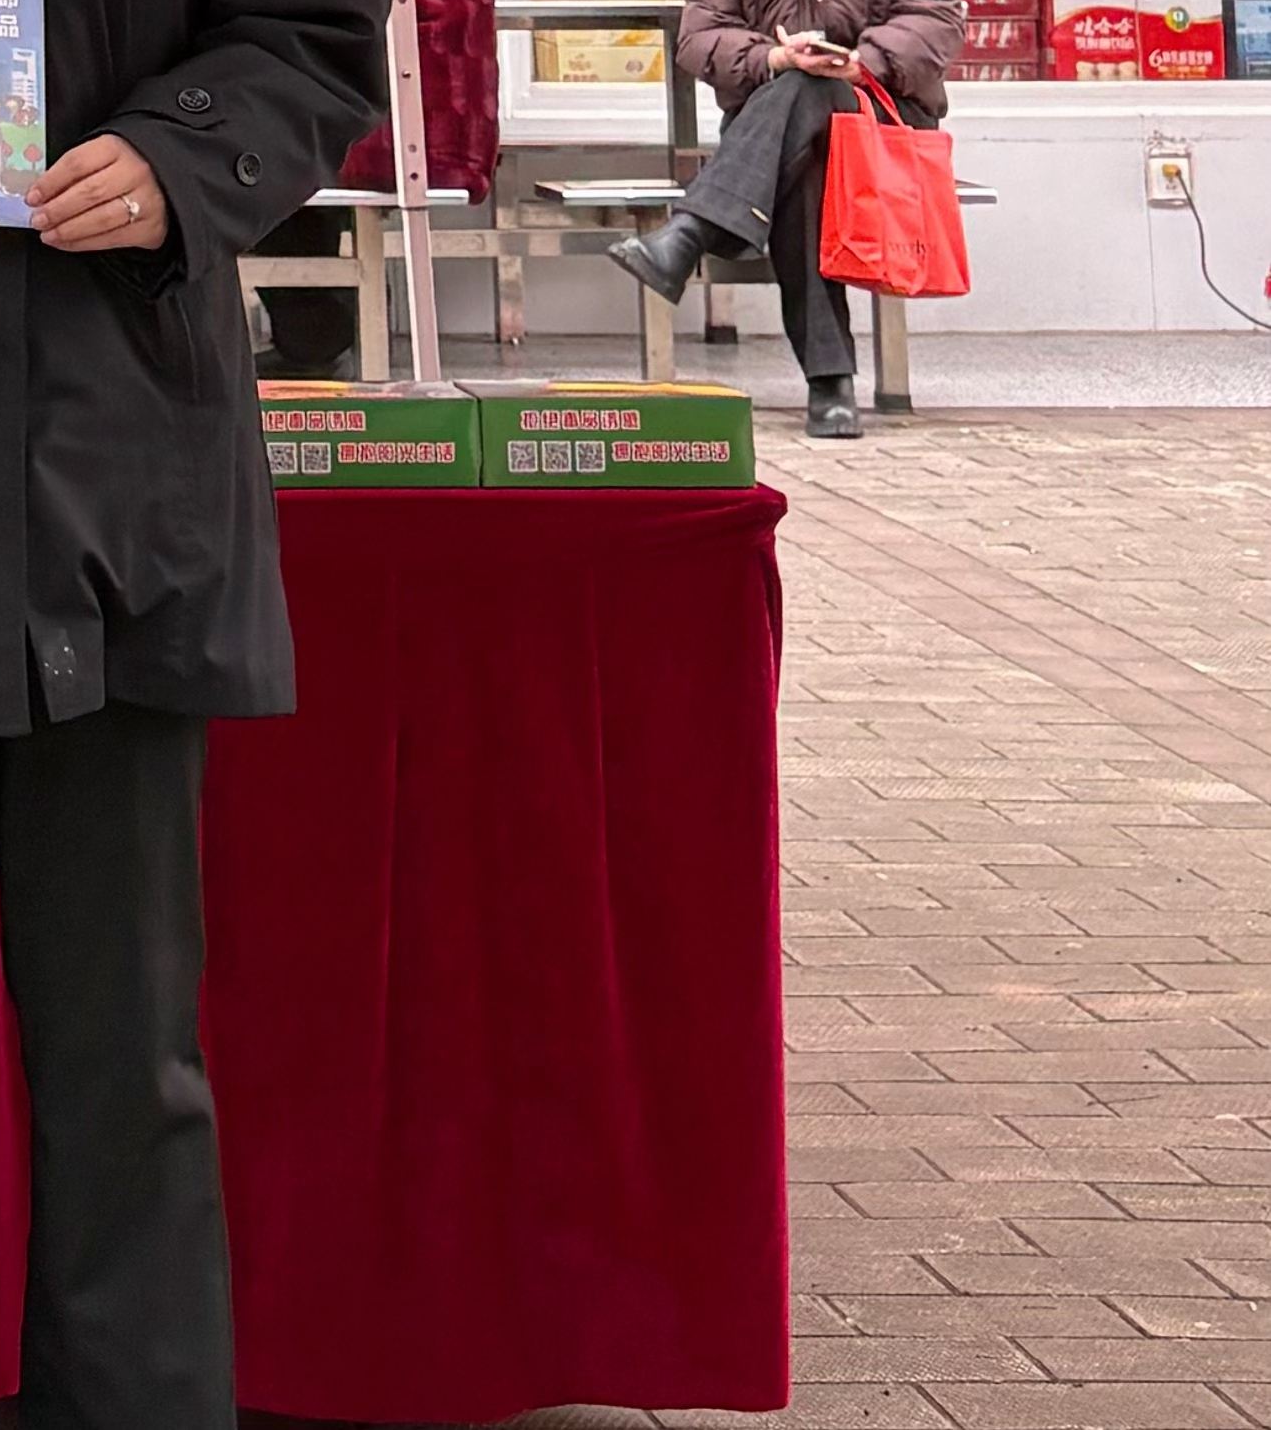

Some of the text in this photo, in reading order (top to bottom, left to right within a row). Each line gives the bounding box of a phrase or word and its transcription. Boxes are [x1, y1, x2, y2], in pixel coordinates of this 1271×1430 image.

[1073, 15, 1134, 36] 娃哈哈
[261, 410, 366, 431] 绝毒品诱惑
